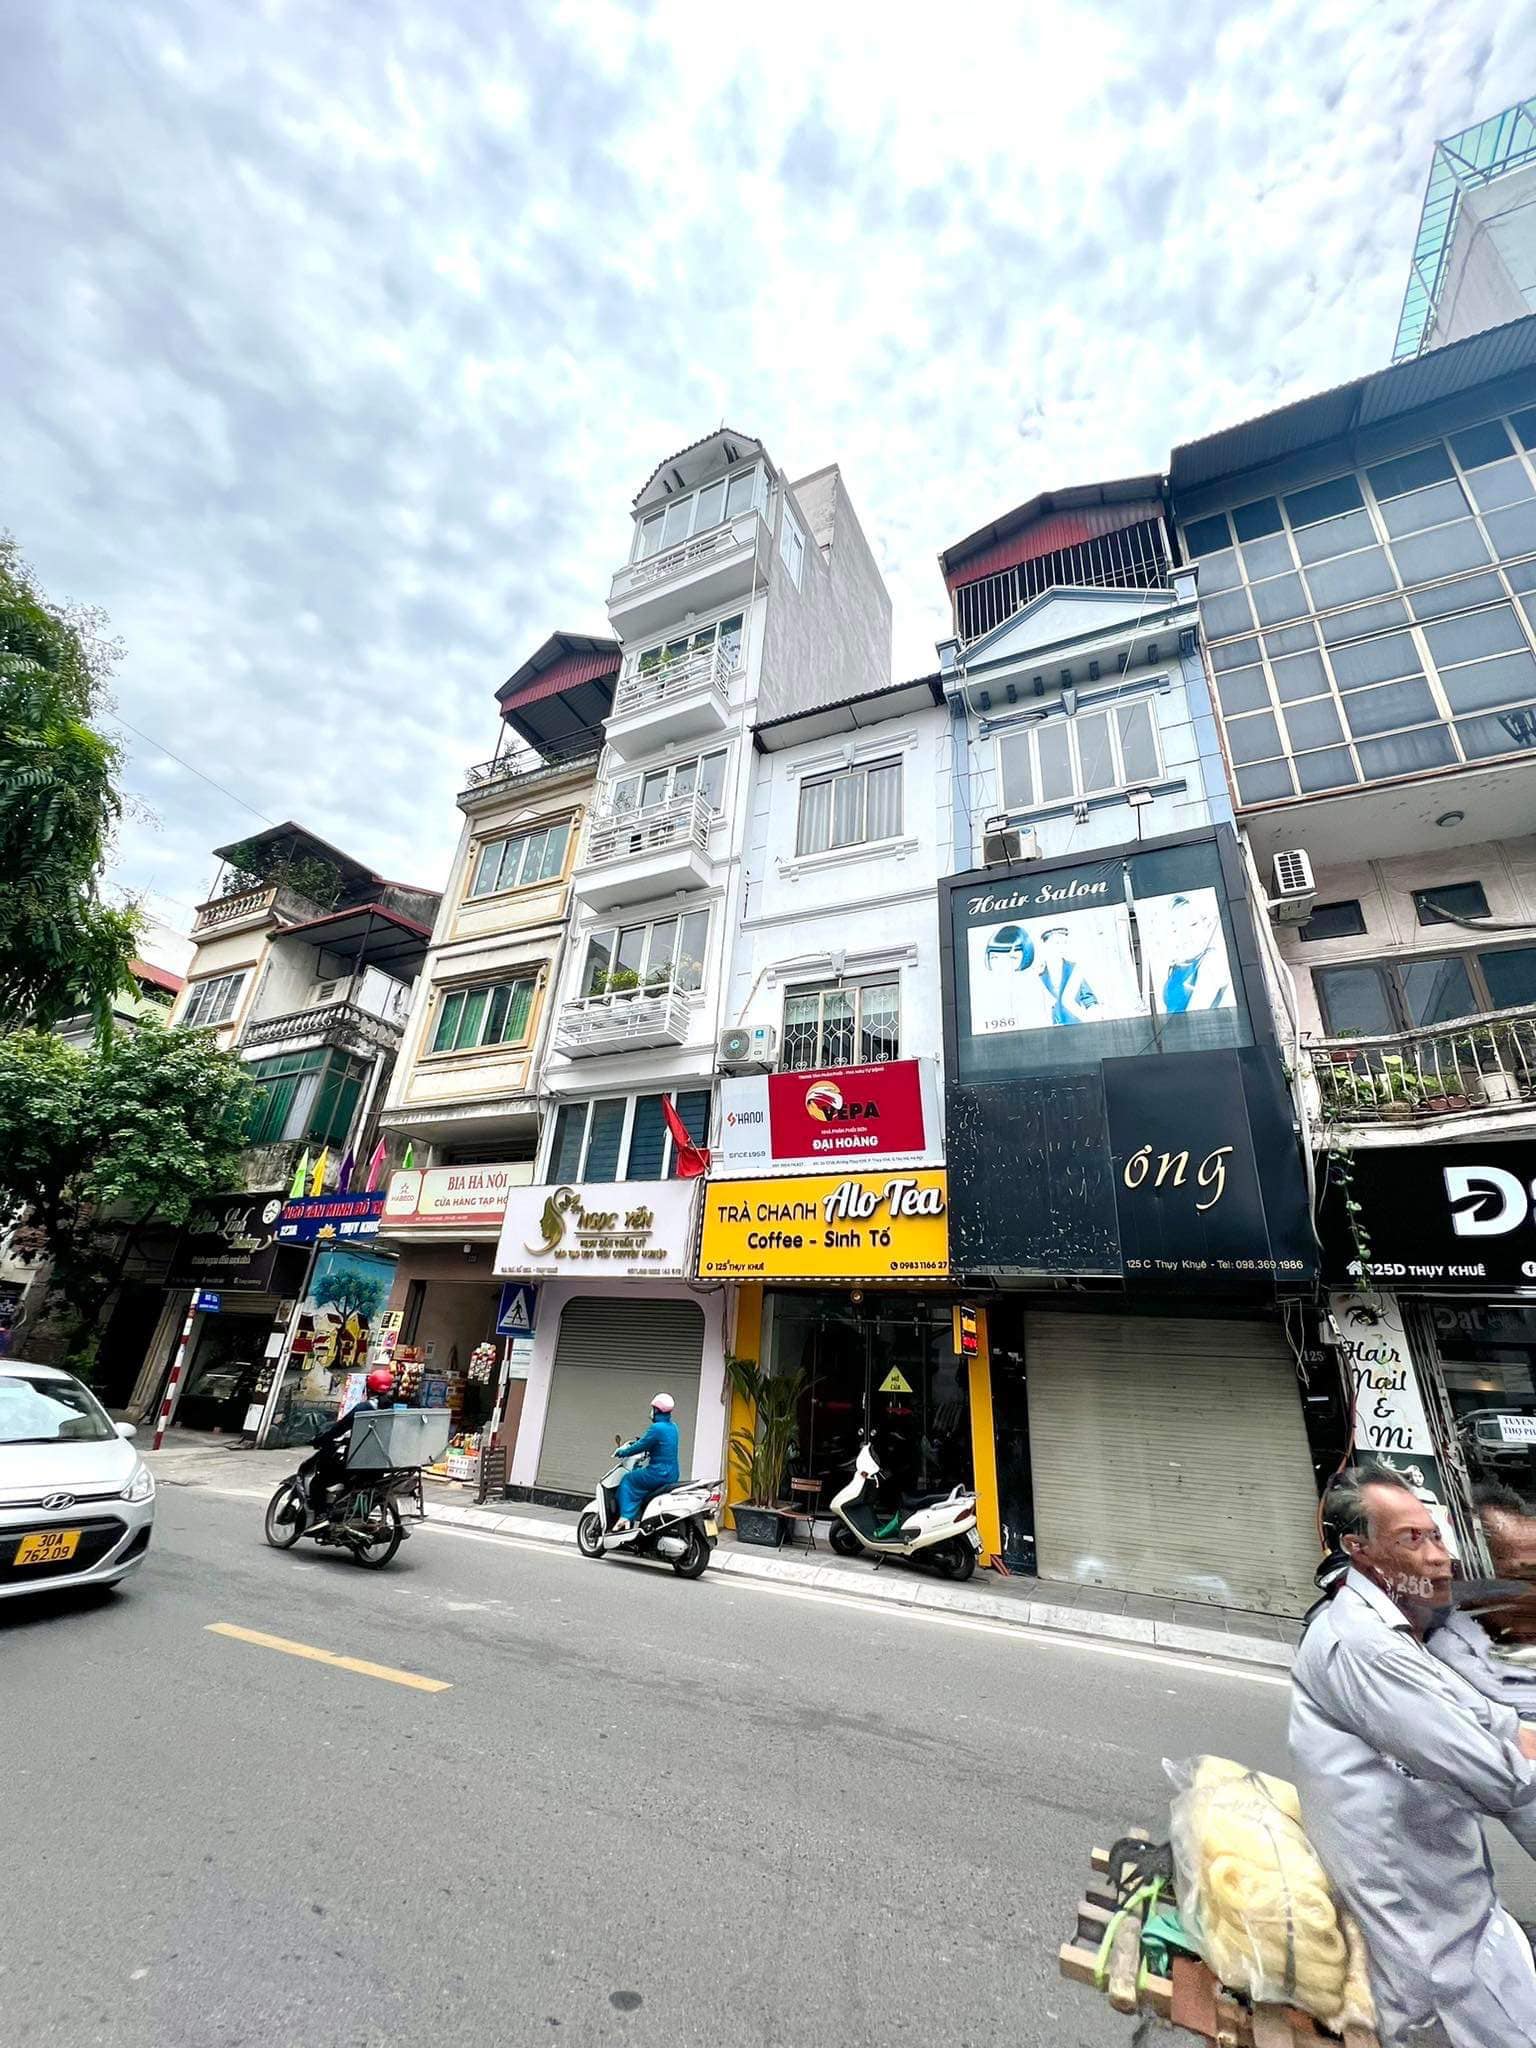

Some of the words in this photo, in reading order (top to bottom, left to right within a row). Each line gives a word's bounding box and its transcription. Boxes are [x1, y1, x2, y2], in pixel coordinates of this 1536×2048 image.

[967, 891, 1029, 915] Hair
[1035, 879, 1109, 904] Salon
[984, 1017, 1016, 1030] 1986
[812, 1138, 834, 1152] ĐẠI
[835, 1134, 879, 1149] HOÀNG
[448, 1175, 465, 1190] BIA
[718, 1200, 751, 1223] TRÀ
[756, 1202, 817, 1222] CHANH
[822, 1180, 882, 1224] Alo
[883, 1178, 945, 1217] Tea
[748, 1231, 803, 1249] Coffee
[824, 1229, 860, 1248] Sinh
[869, 1226, 891, 1247] Tố
[1235, 1259, 1304, 1270] 098.369.1986
[1408, 1265, 1449, 1279] THỤY
[1449, 1263, 1487, 1277] KHUÊ
[1345, 1340, 1401, 1364] Hair
[1352, 1369, 1407, 1391] Nail
[1373, 1397, 1395, 1418] &
[1369, 1425, 1414, 1450] Mi
[38, 1533, 65, 1548] 30A
[22, 1545, 70, 1564] 762.09
